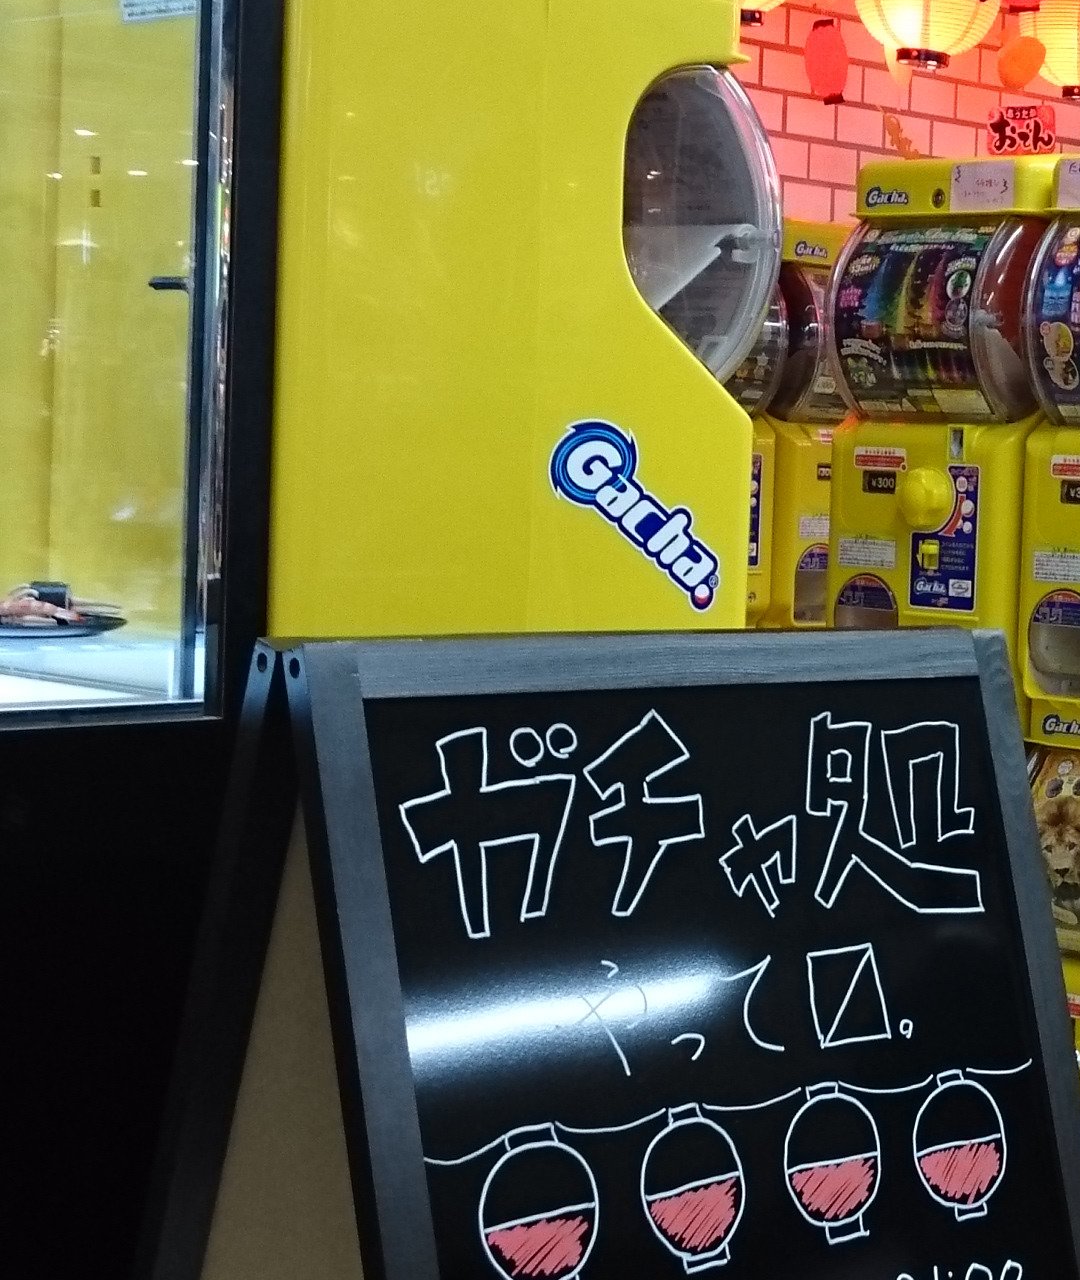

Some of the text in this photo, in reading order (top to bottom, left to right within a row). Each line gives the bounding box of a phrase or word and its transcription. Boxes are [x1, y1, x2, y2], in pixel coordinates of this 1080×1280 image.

[988, 111, 1054, 152] おでん
[399, 709, 985, 939] ガチャ処
